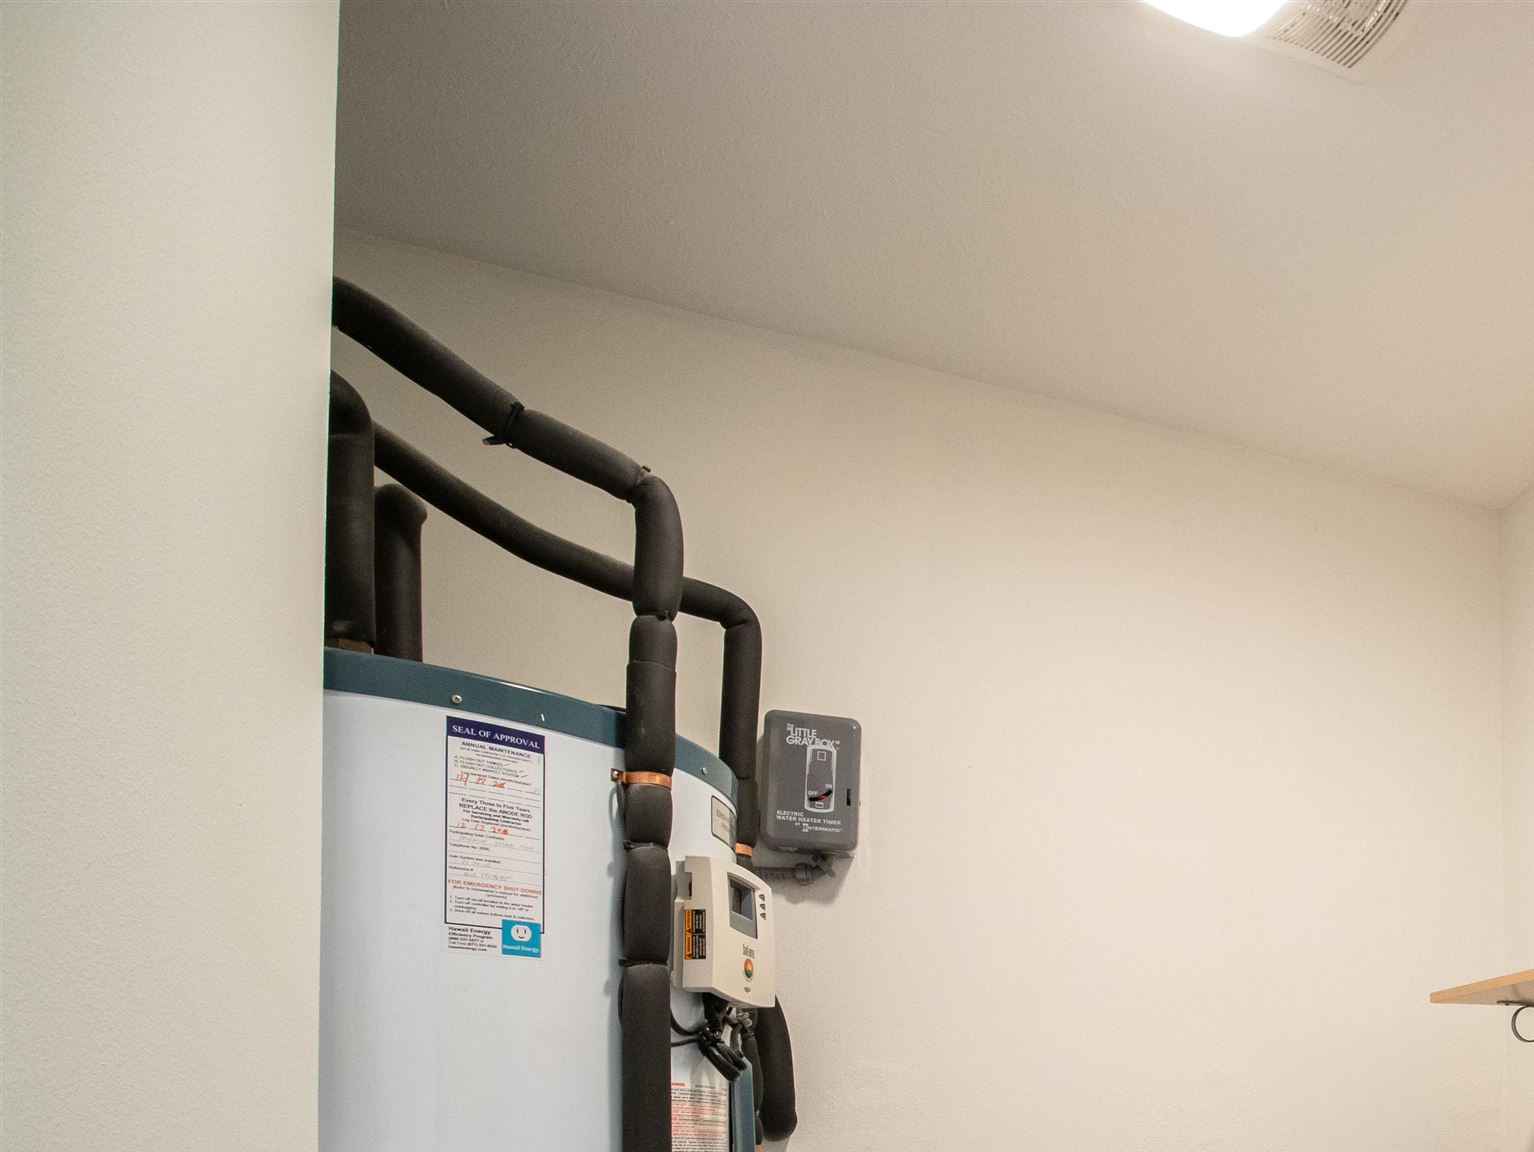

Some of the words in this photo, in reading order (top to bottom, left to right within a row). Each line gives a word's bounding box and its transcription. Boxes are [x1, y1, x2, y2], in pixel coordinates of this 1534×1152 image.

[452, 725, 477, 736] SEAL
[479, 730, 491, 738] OF
[492, 733, 540, 749] APPROVAL
[489, 747, 531, 758] MAINTENANCE
[463, 881, 502, 890] EMERGENCY
